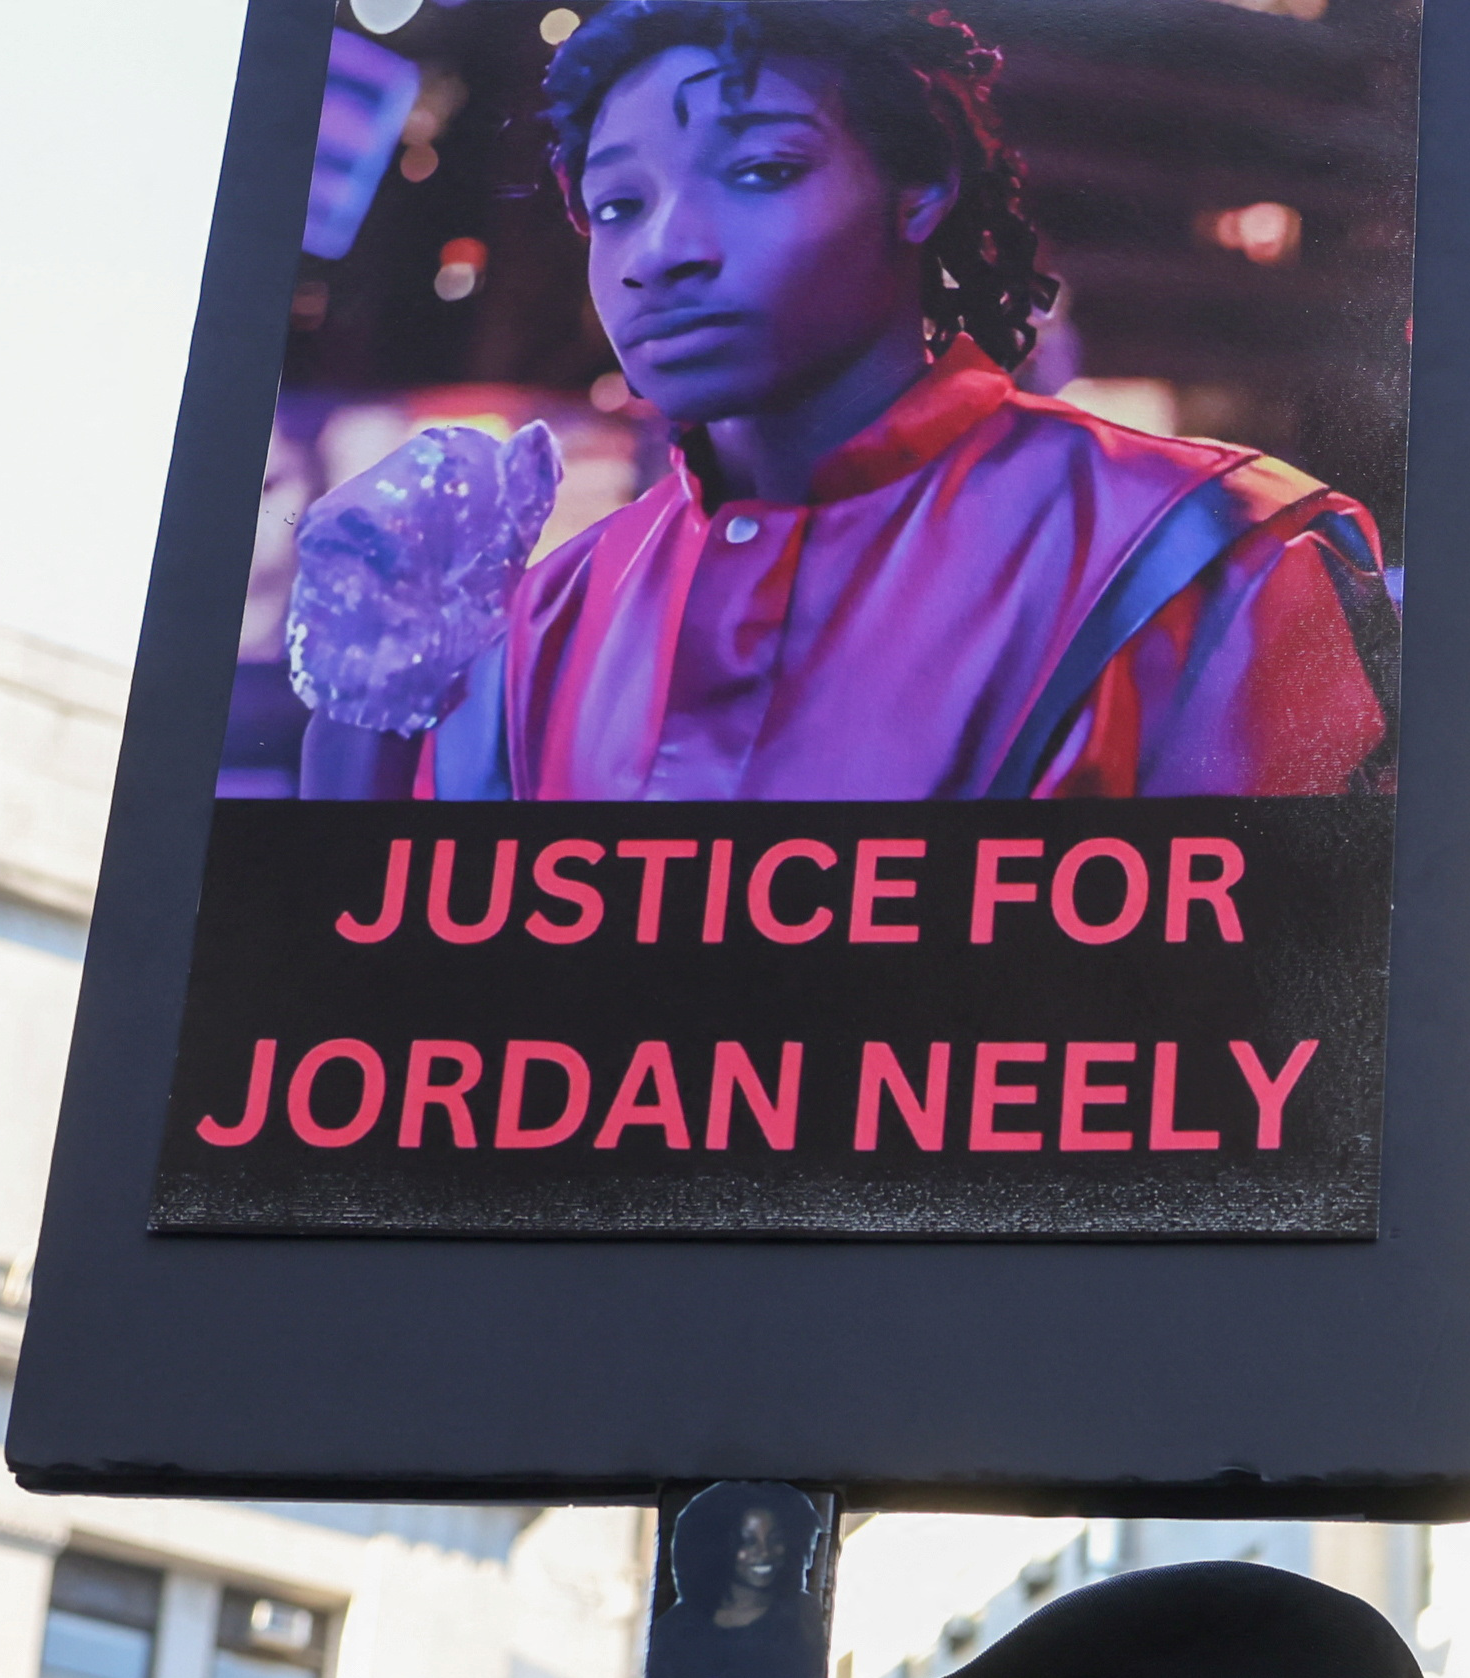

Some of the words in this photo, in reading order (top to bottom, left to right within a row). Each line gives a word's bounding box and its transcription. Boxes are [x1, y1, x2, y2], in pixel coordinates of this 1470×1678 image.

[335, 839, 927, 945] JUSTICE
[970, 837, 1245, 944] FOR
[196, 1038, 803, 1150] JORDAN
[854, 1039, 1320, 1151] NEELY
